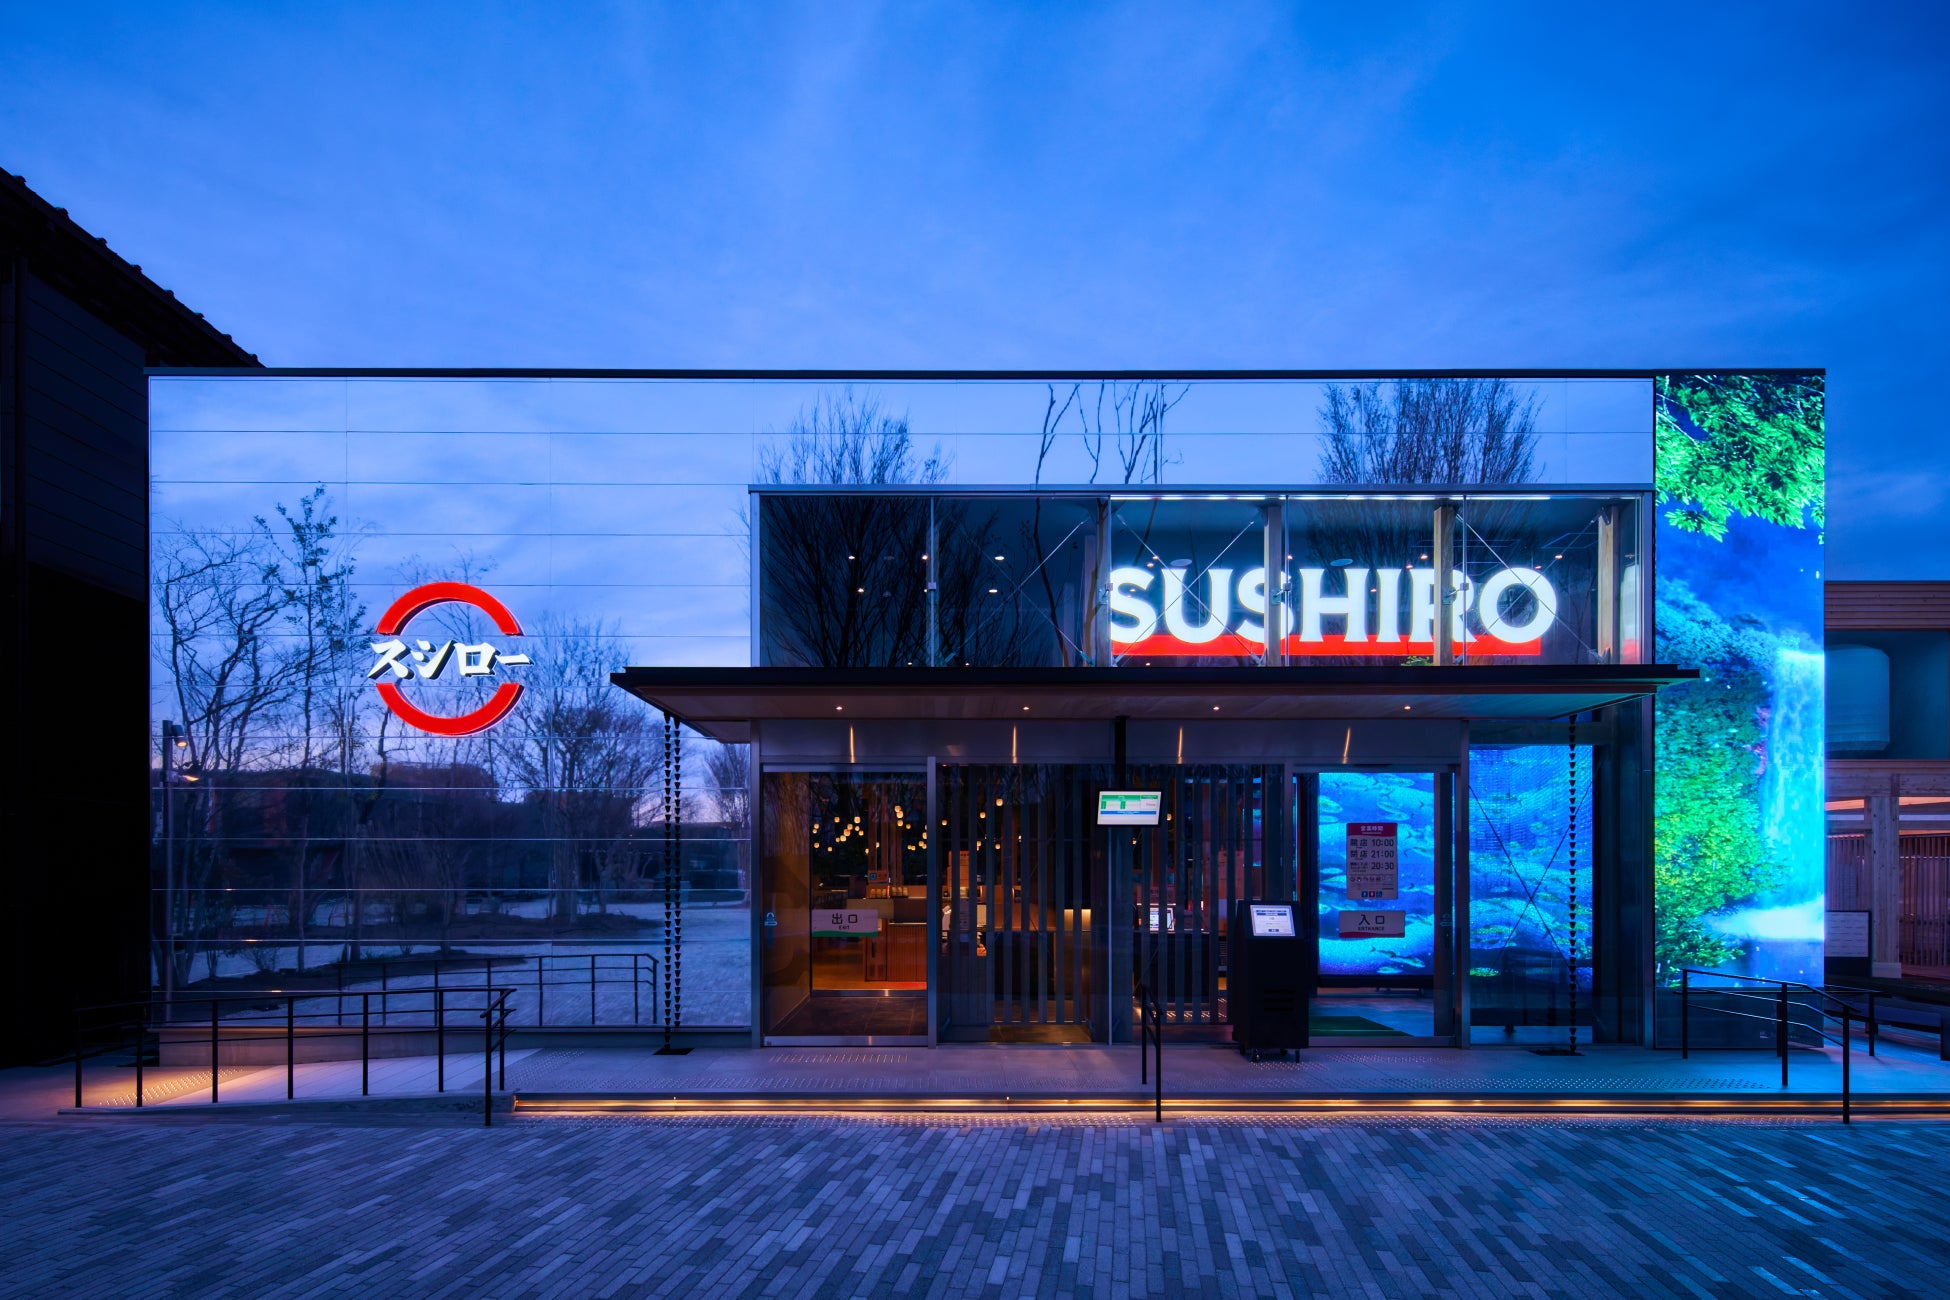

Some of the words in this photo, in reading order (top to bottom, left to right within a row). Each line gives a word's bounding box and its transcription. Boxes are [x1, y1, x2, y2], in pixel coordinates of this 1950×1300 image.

[1110, 567, 1557, 643] SUSHIRO
[367, 639, 534, 680] スシロー
[1371, 839, 1394, 847] 10:00
[1371, 850, 1394, 859] 21:00
[1371, 862, 1394, 870] 20:30
[832, 913, 858, 924] 出口
[1359, 914, 1385, 926] 入口
